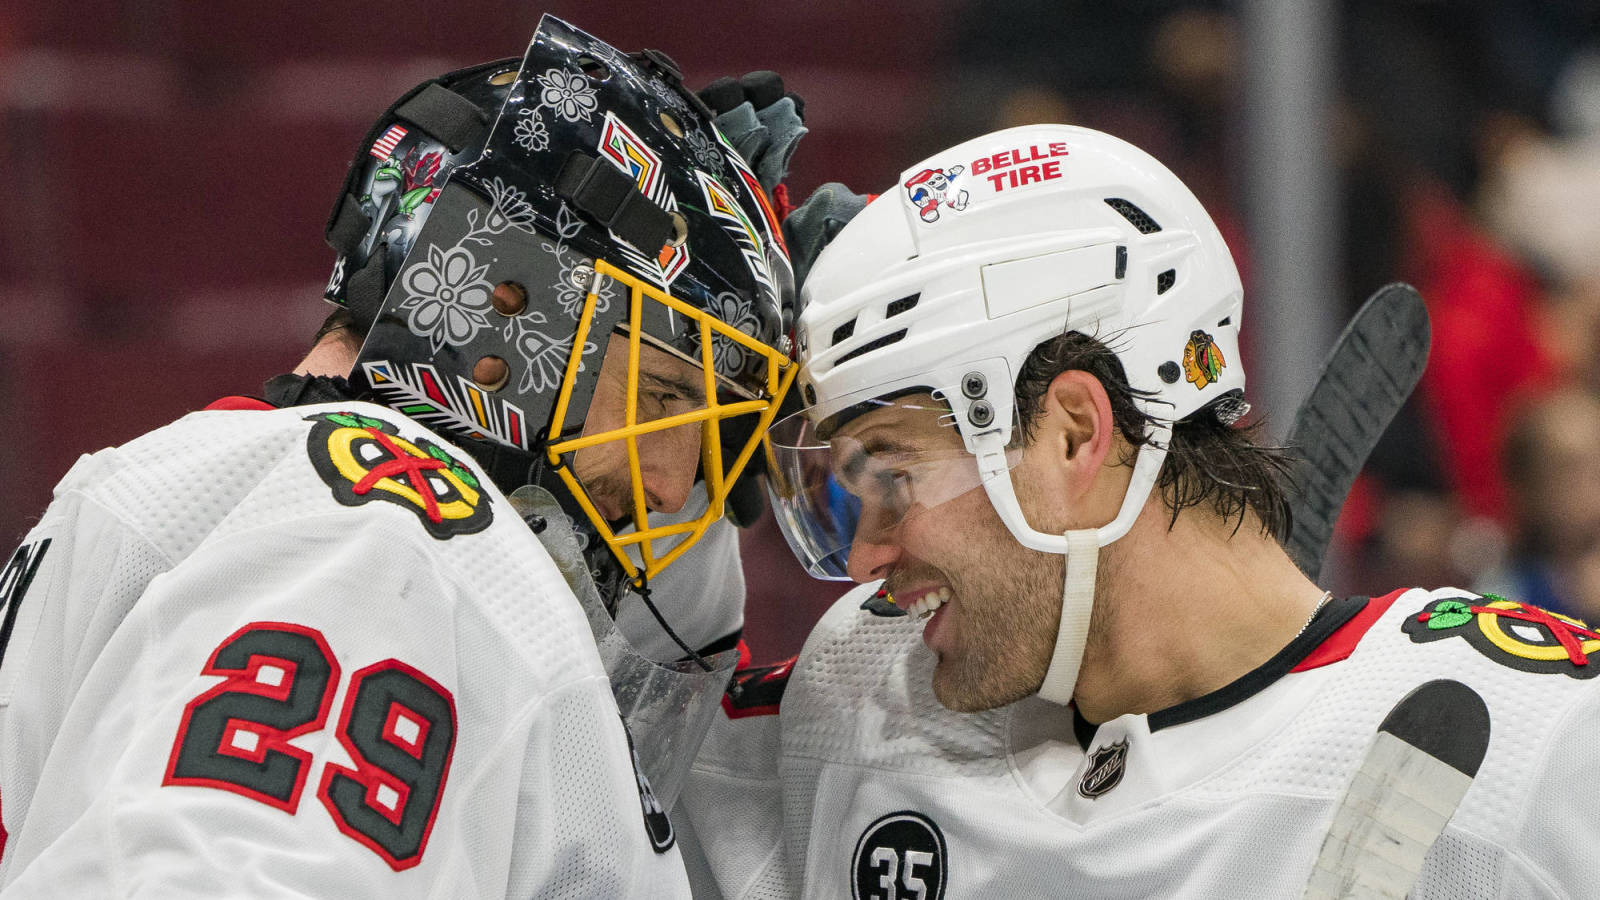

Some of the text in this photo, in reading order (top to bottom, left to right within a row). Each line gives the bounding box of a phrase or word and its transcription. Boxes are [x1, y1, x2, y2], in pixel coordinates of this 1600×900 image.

[971, 142, 1069, 176] BELLE
[987, 161, 1062, 192] TIRE
[161, 621, 458, 873] 29
[1089, 753, 1121, 789] NHL
[870, 846, 934, 900] 35
